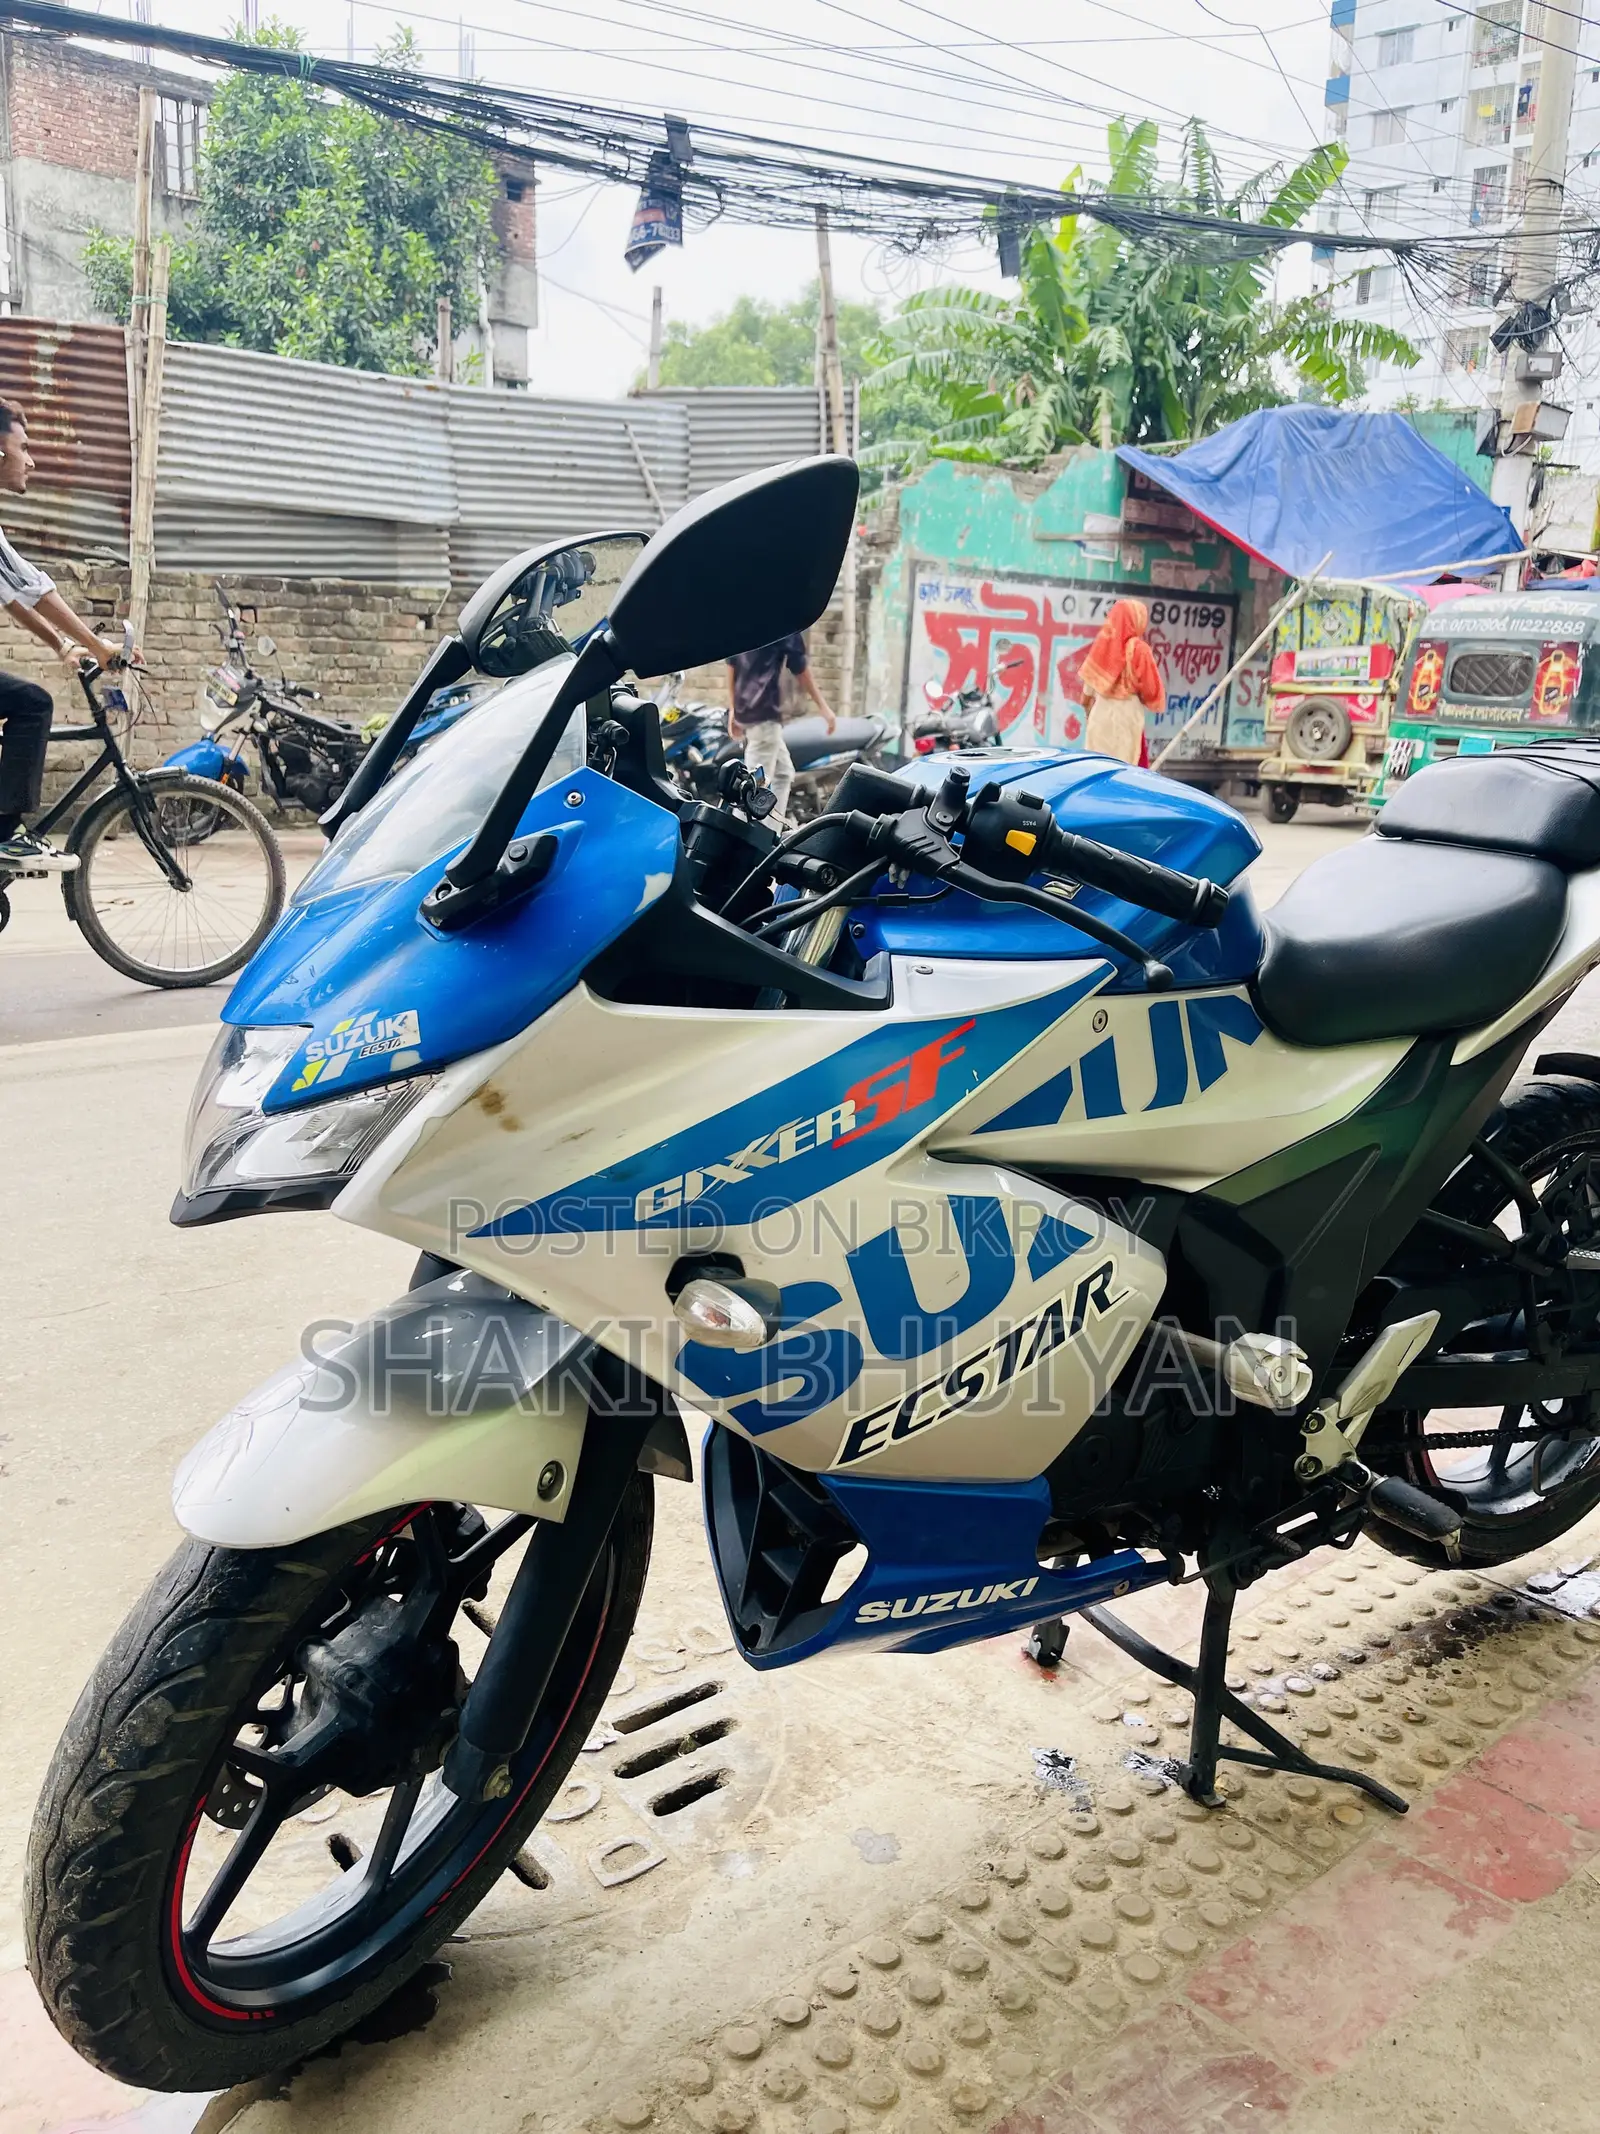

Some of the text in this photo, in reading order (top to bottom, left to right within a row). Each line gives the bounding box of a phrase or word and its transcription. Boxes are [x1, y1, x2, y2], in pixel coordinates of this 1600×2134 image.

[831, 1018, 977, 1150] SF
[836, 1259, 1132, 1467] ECSTAR
[854, 1577, 1040, 1624] SUZUKI
